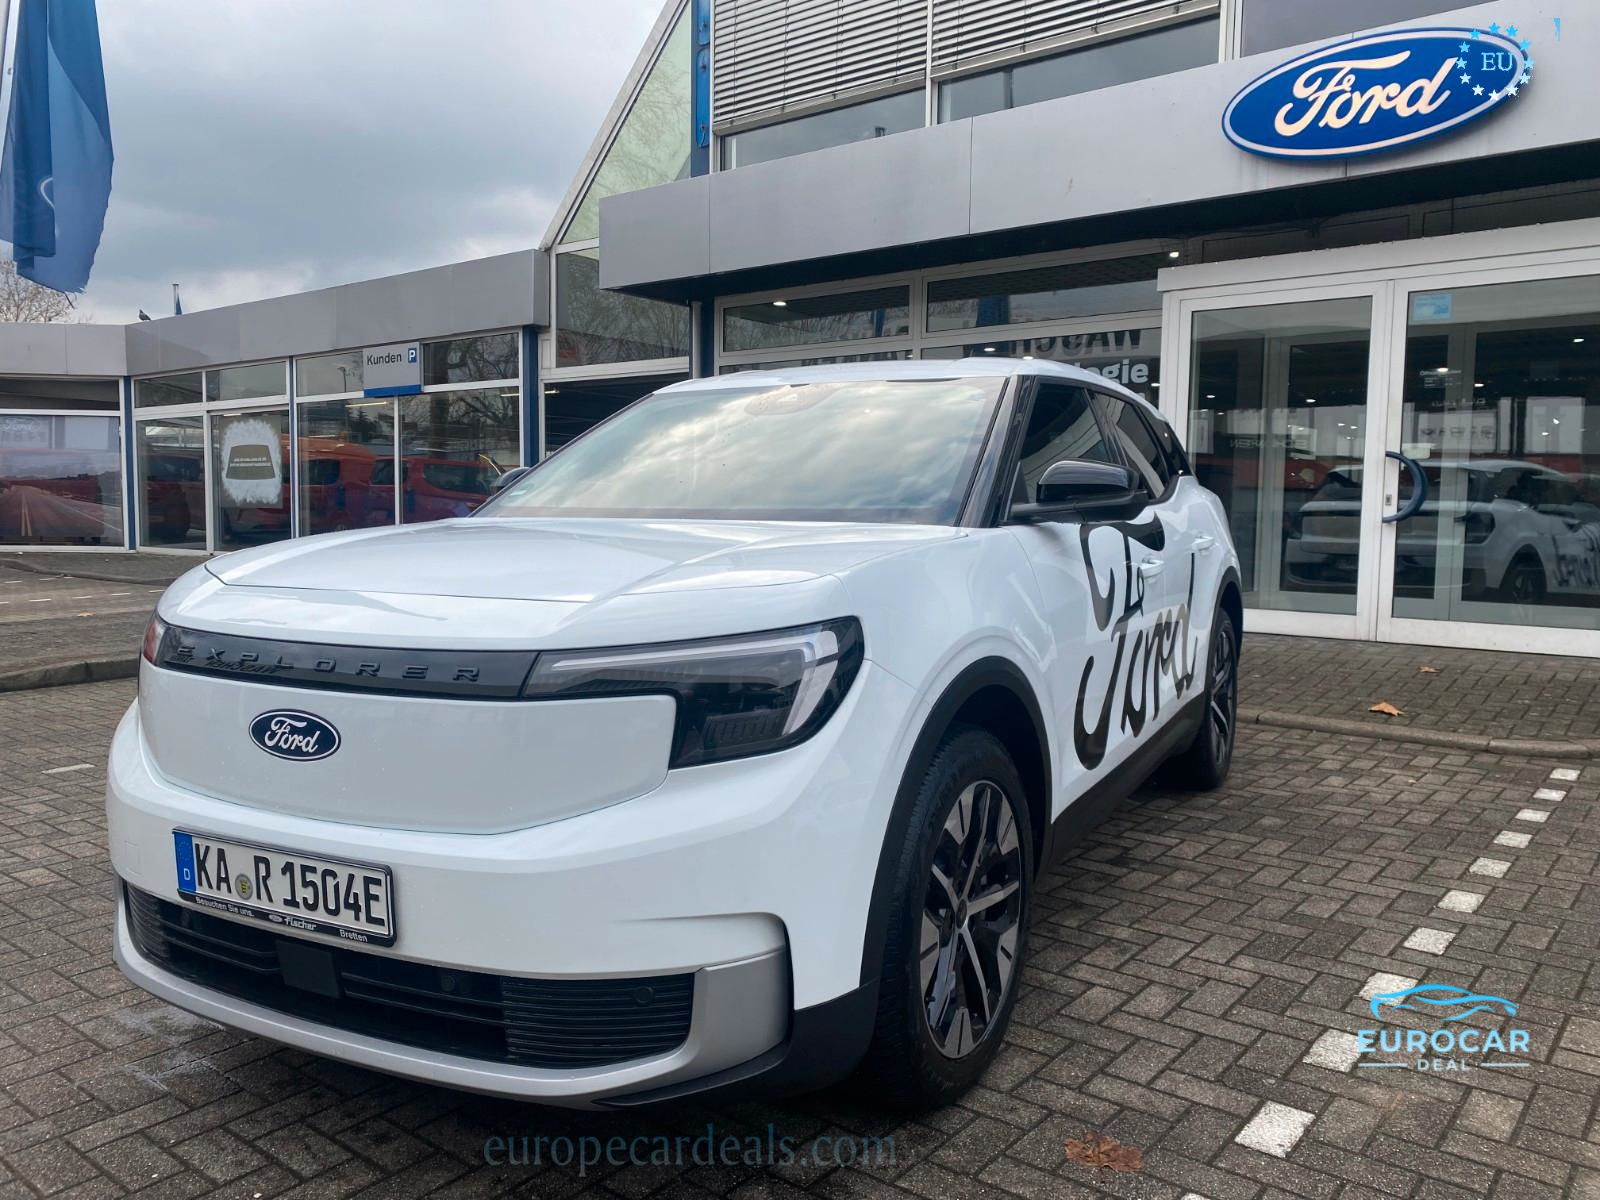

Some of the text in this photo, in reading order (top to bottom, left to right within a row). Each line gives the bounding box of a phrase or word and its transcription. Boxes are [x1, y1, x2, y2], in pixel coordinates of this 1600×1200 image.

[1274, 50, 1459, 136] Ford
[366, 350, 416, 366] Kunden P
[1073, 511, 1199, 771] Ford
[176, 645, 480, 682] EXPLORER
[264, 717, 321, 753] Ford
[182, 843, 386, 927] D KA R 1504E
[196, 896, 228, 912] Besuchen
[227, 904, 240, 914] Sie
[339, 929, 368, 943] Bretten
